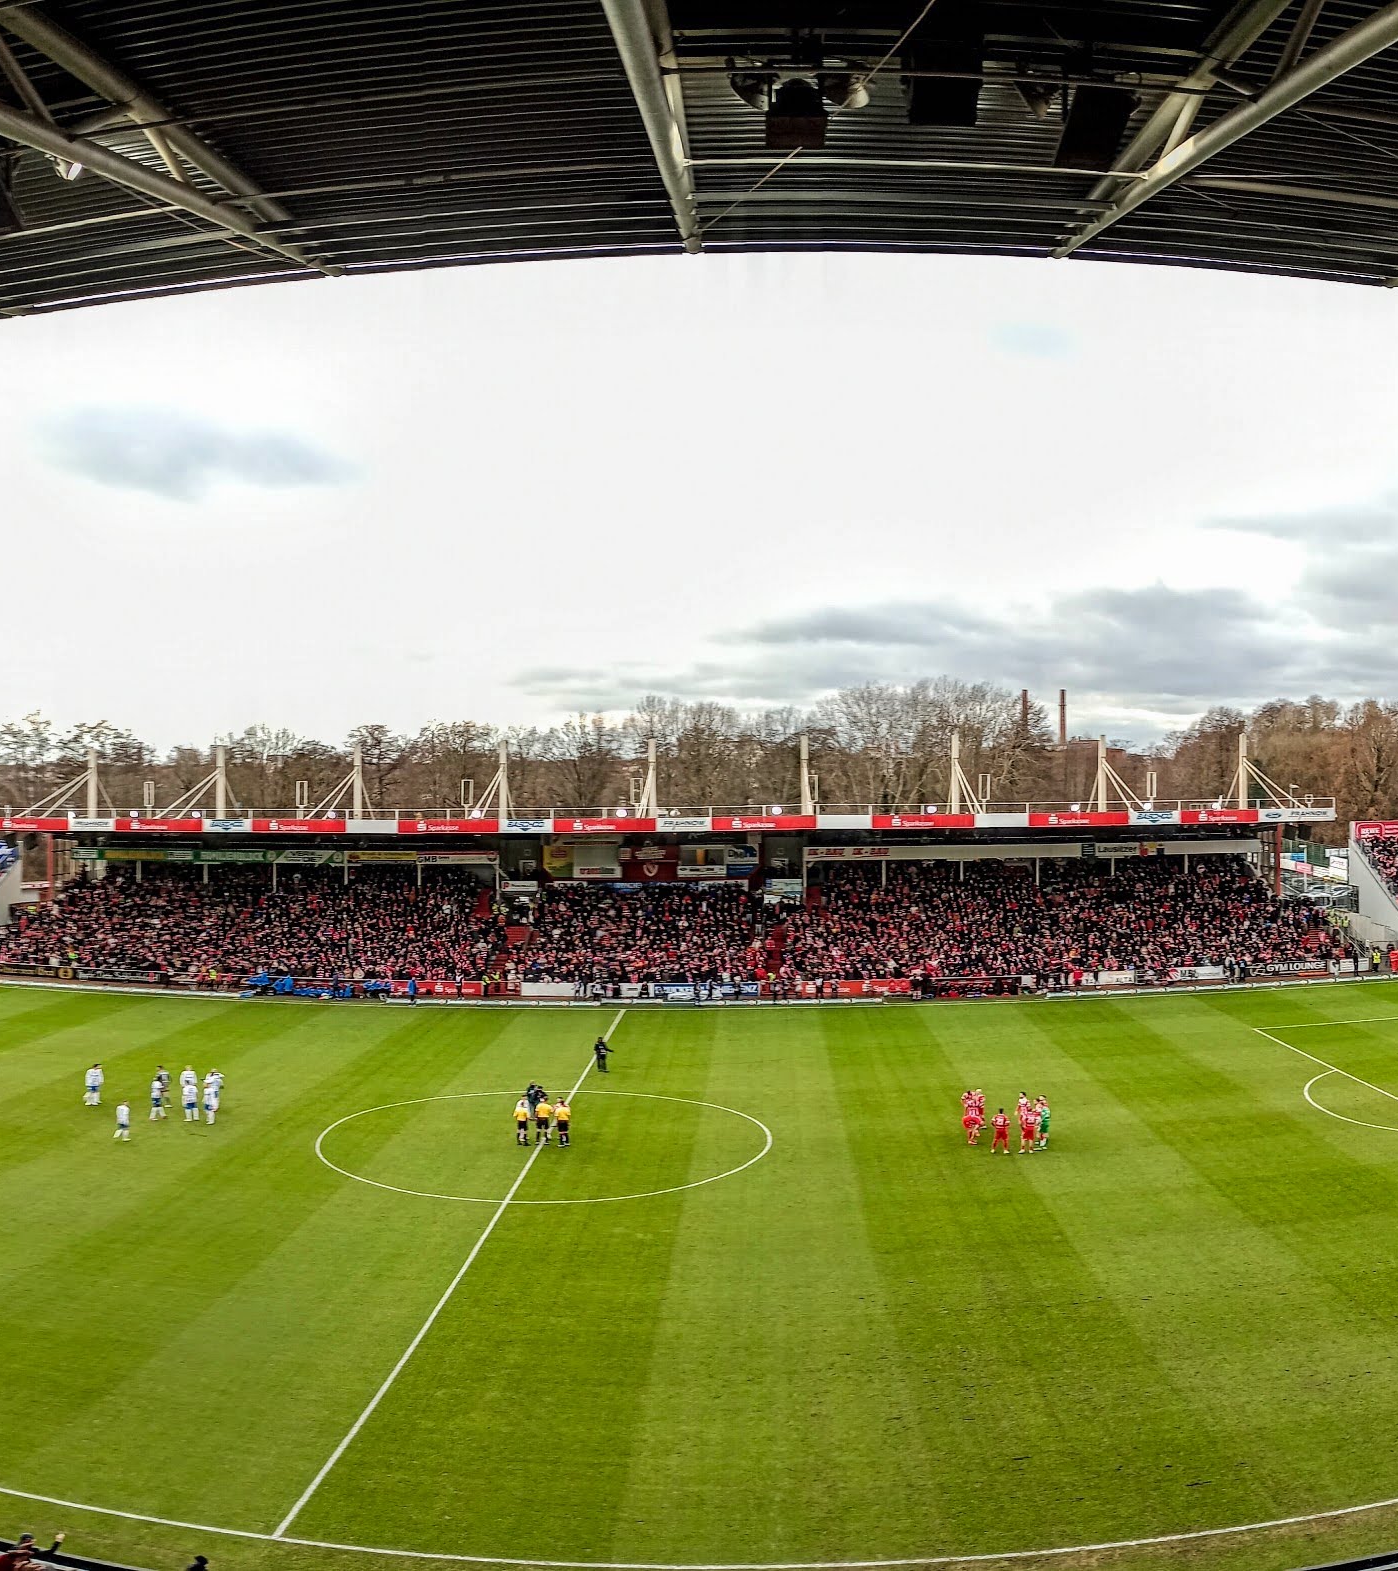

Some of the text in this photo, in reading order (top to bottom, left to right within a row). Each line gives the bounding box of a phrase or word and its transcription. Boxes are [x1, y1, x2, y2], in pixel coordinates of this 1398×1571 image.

[1098, 845, 1139, 853] Lausitzer
[1266, 961, 1327, 972] GYM LOUNGE
